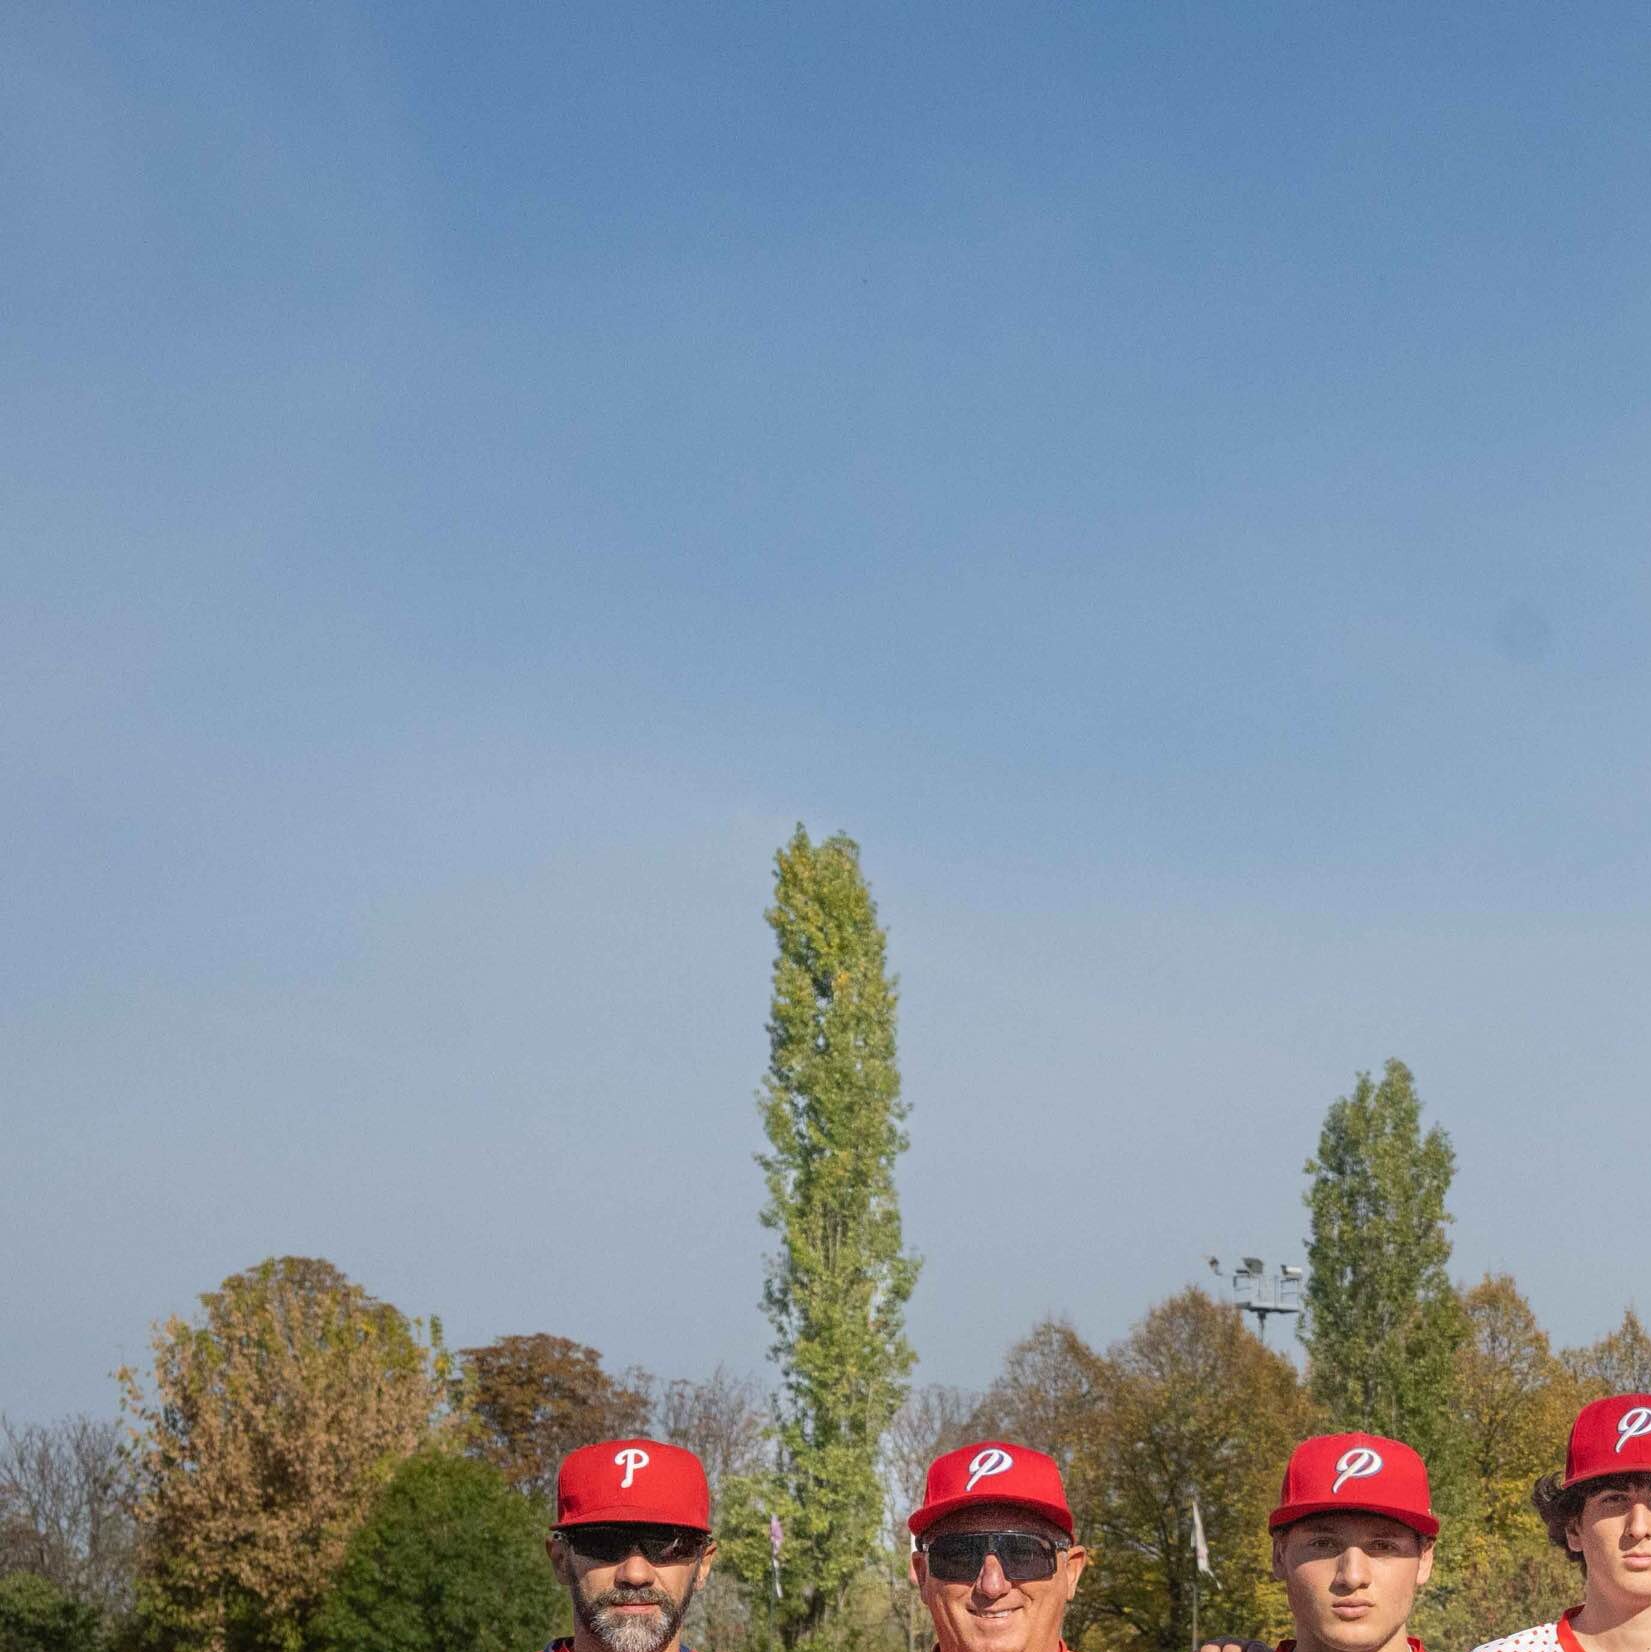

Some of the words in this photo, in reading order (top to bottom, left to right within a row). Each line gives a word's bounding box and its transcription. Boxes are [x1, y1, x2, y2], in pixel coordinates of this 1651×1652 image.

[614, 1448, 650, 1489] P
[964, 1448, 1013, 1493] P
[1332, 1446, 1384, 1494] P
